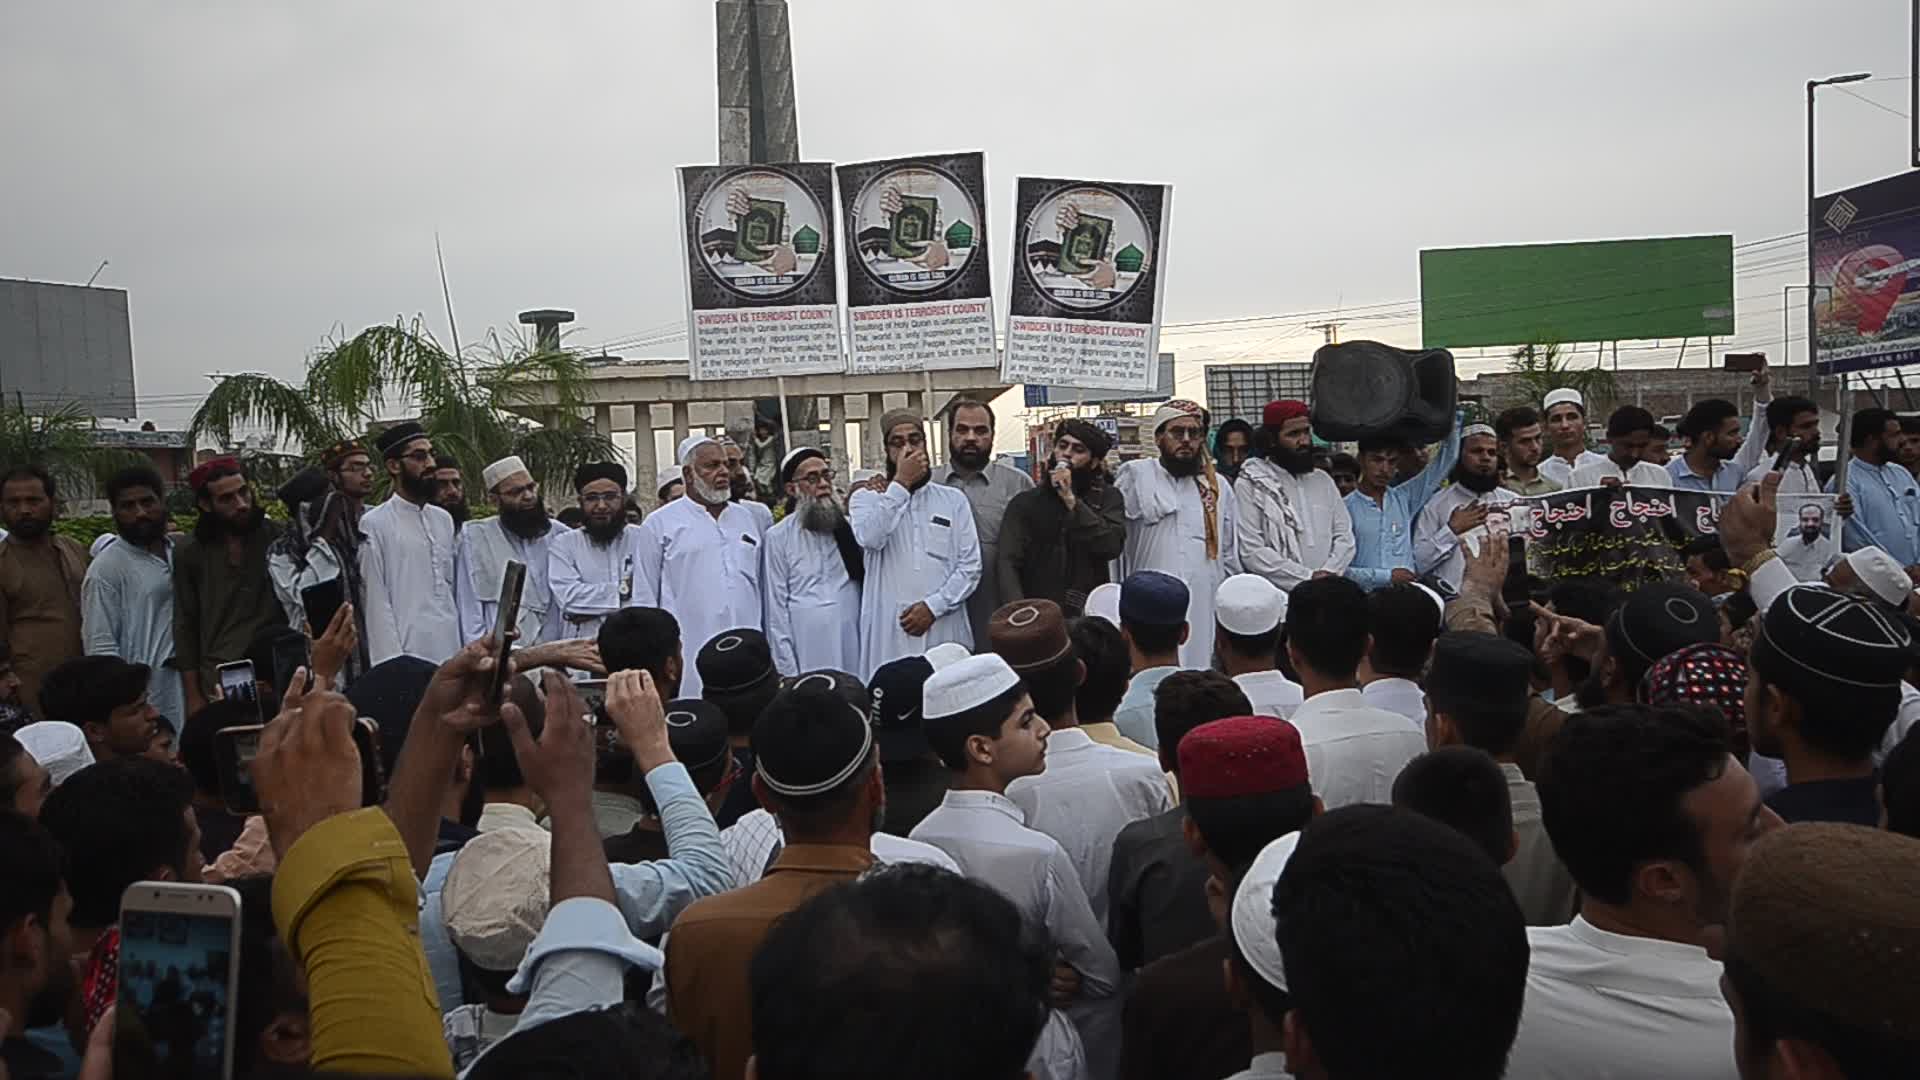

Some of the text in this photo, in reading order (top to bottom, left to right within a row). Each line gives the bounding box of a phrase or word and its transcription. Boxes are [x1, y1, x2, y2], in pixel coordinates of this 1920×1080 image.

[698, 309, 832, 324] SWIDDEN IS TERRORIST COUNTY
[853, 303, 985, 320] SWIDDEN IS TERRORIST COUNTY
[738, 325, 755, 334] Holy
[893, 320, 908, 329] Holy
[1013, 320, 1145, 338] SWIDDEN IS TERRORIST COUNTY
[698, 337, 711, 345] The
[717, 336, 736, 344] world
[751, 335, 765, 344] only
[855, 333, 866, 341] The
[905, 330, 919, 339] only
[1050, 334, 1066, 344] Holy
[949, 337, 975, 346] making
[979, 336, 990, 344] fun
[796, 343, 822, 352] making
[1029, 343, 1047, 351] world
[1061, 345, 1075, 355] only
[784, 355, 796, 363] but
[1104, 359, 1129, 369] making
[1133, 361, 1144, 369] fun
[1113, 370, 1126, 378] this
[1128, 371, 1143, 379] time
